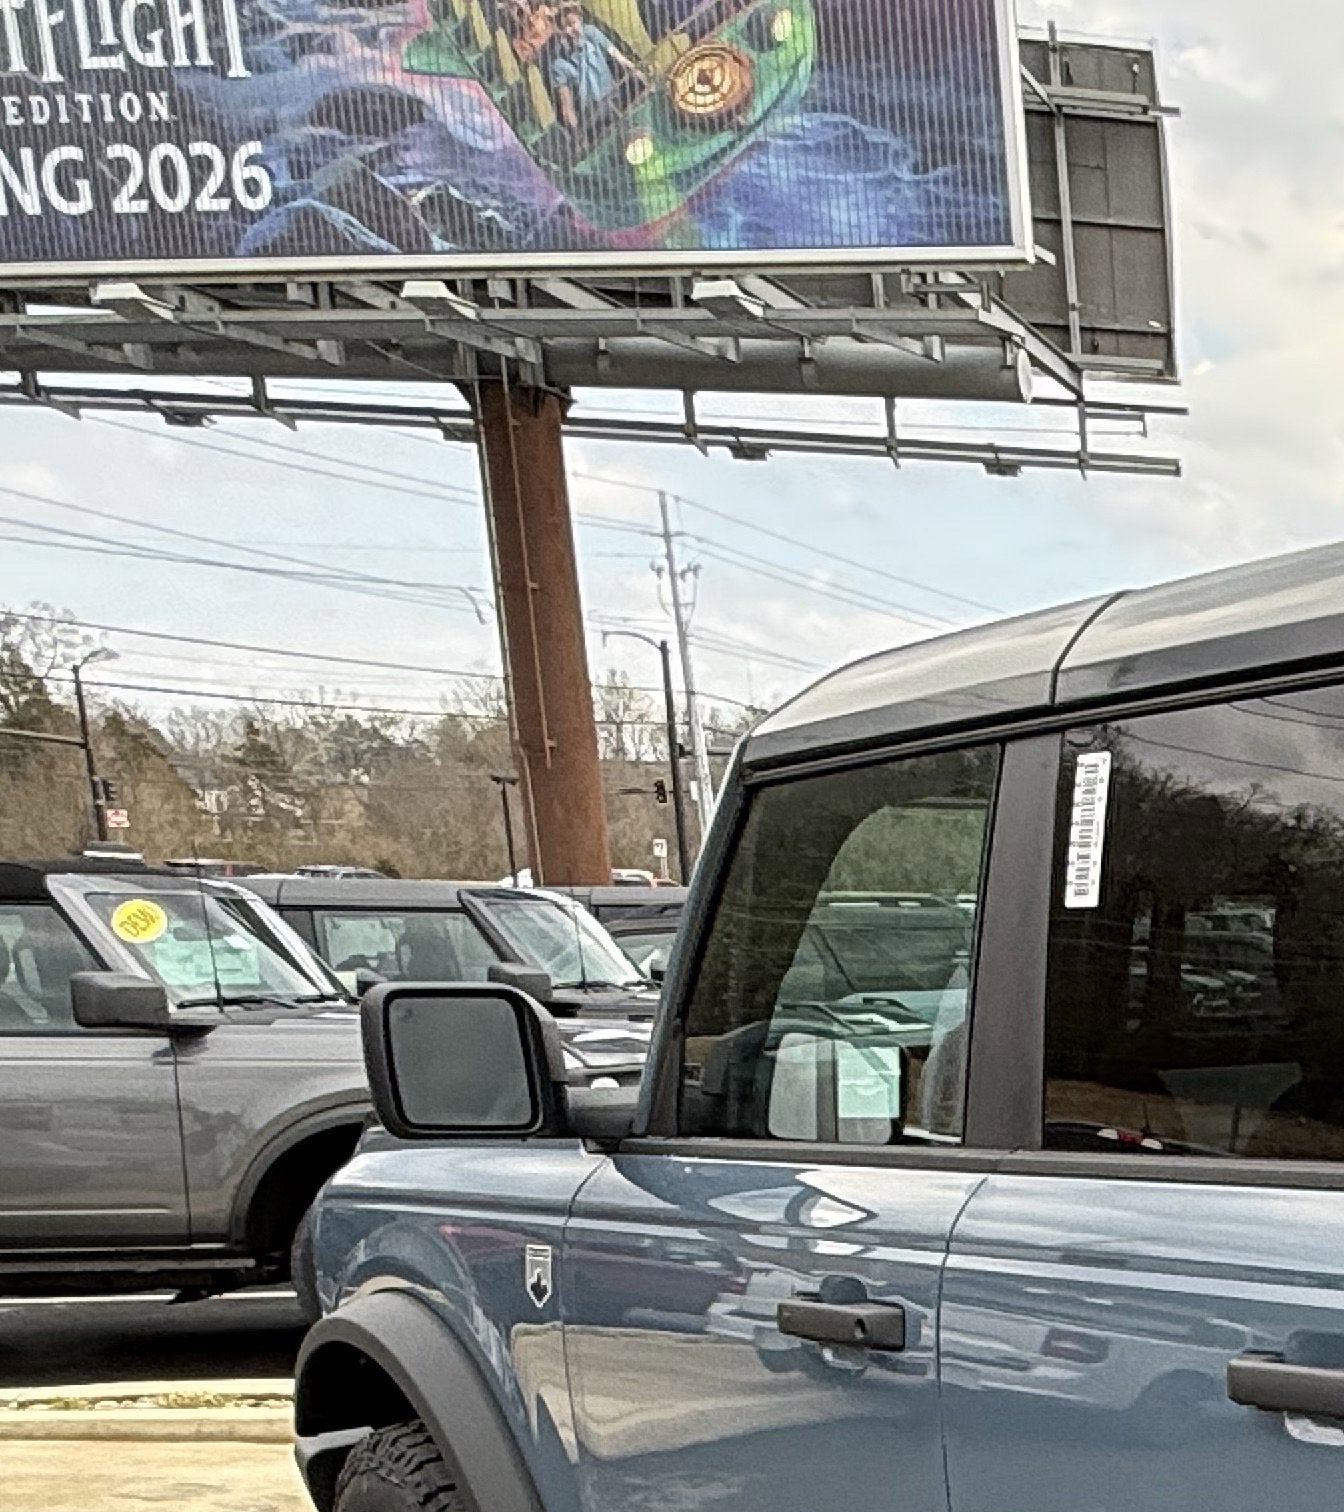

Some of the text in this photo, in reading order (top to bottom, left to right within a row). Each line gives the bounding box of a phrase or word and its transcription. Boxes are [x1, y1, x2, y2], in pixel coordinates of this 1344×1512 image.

[2, 91, 172, 125] EDITION
[0, 140, 272, 216] NG 2026
